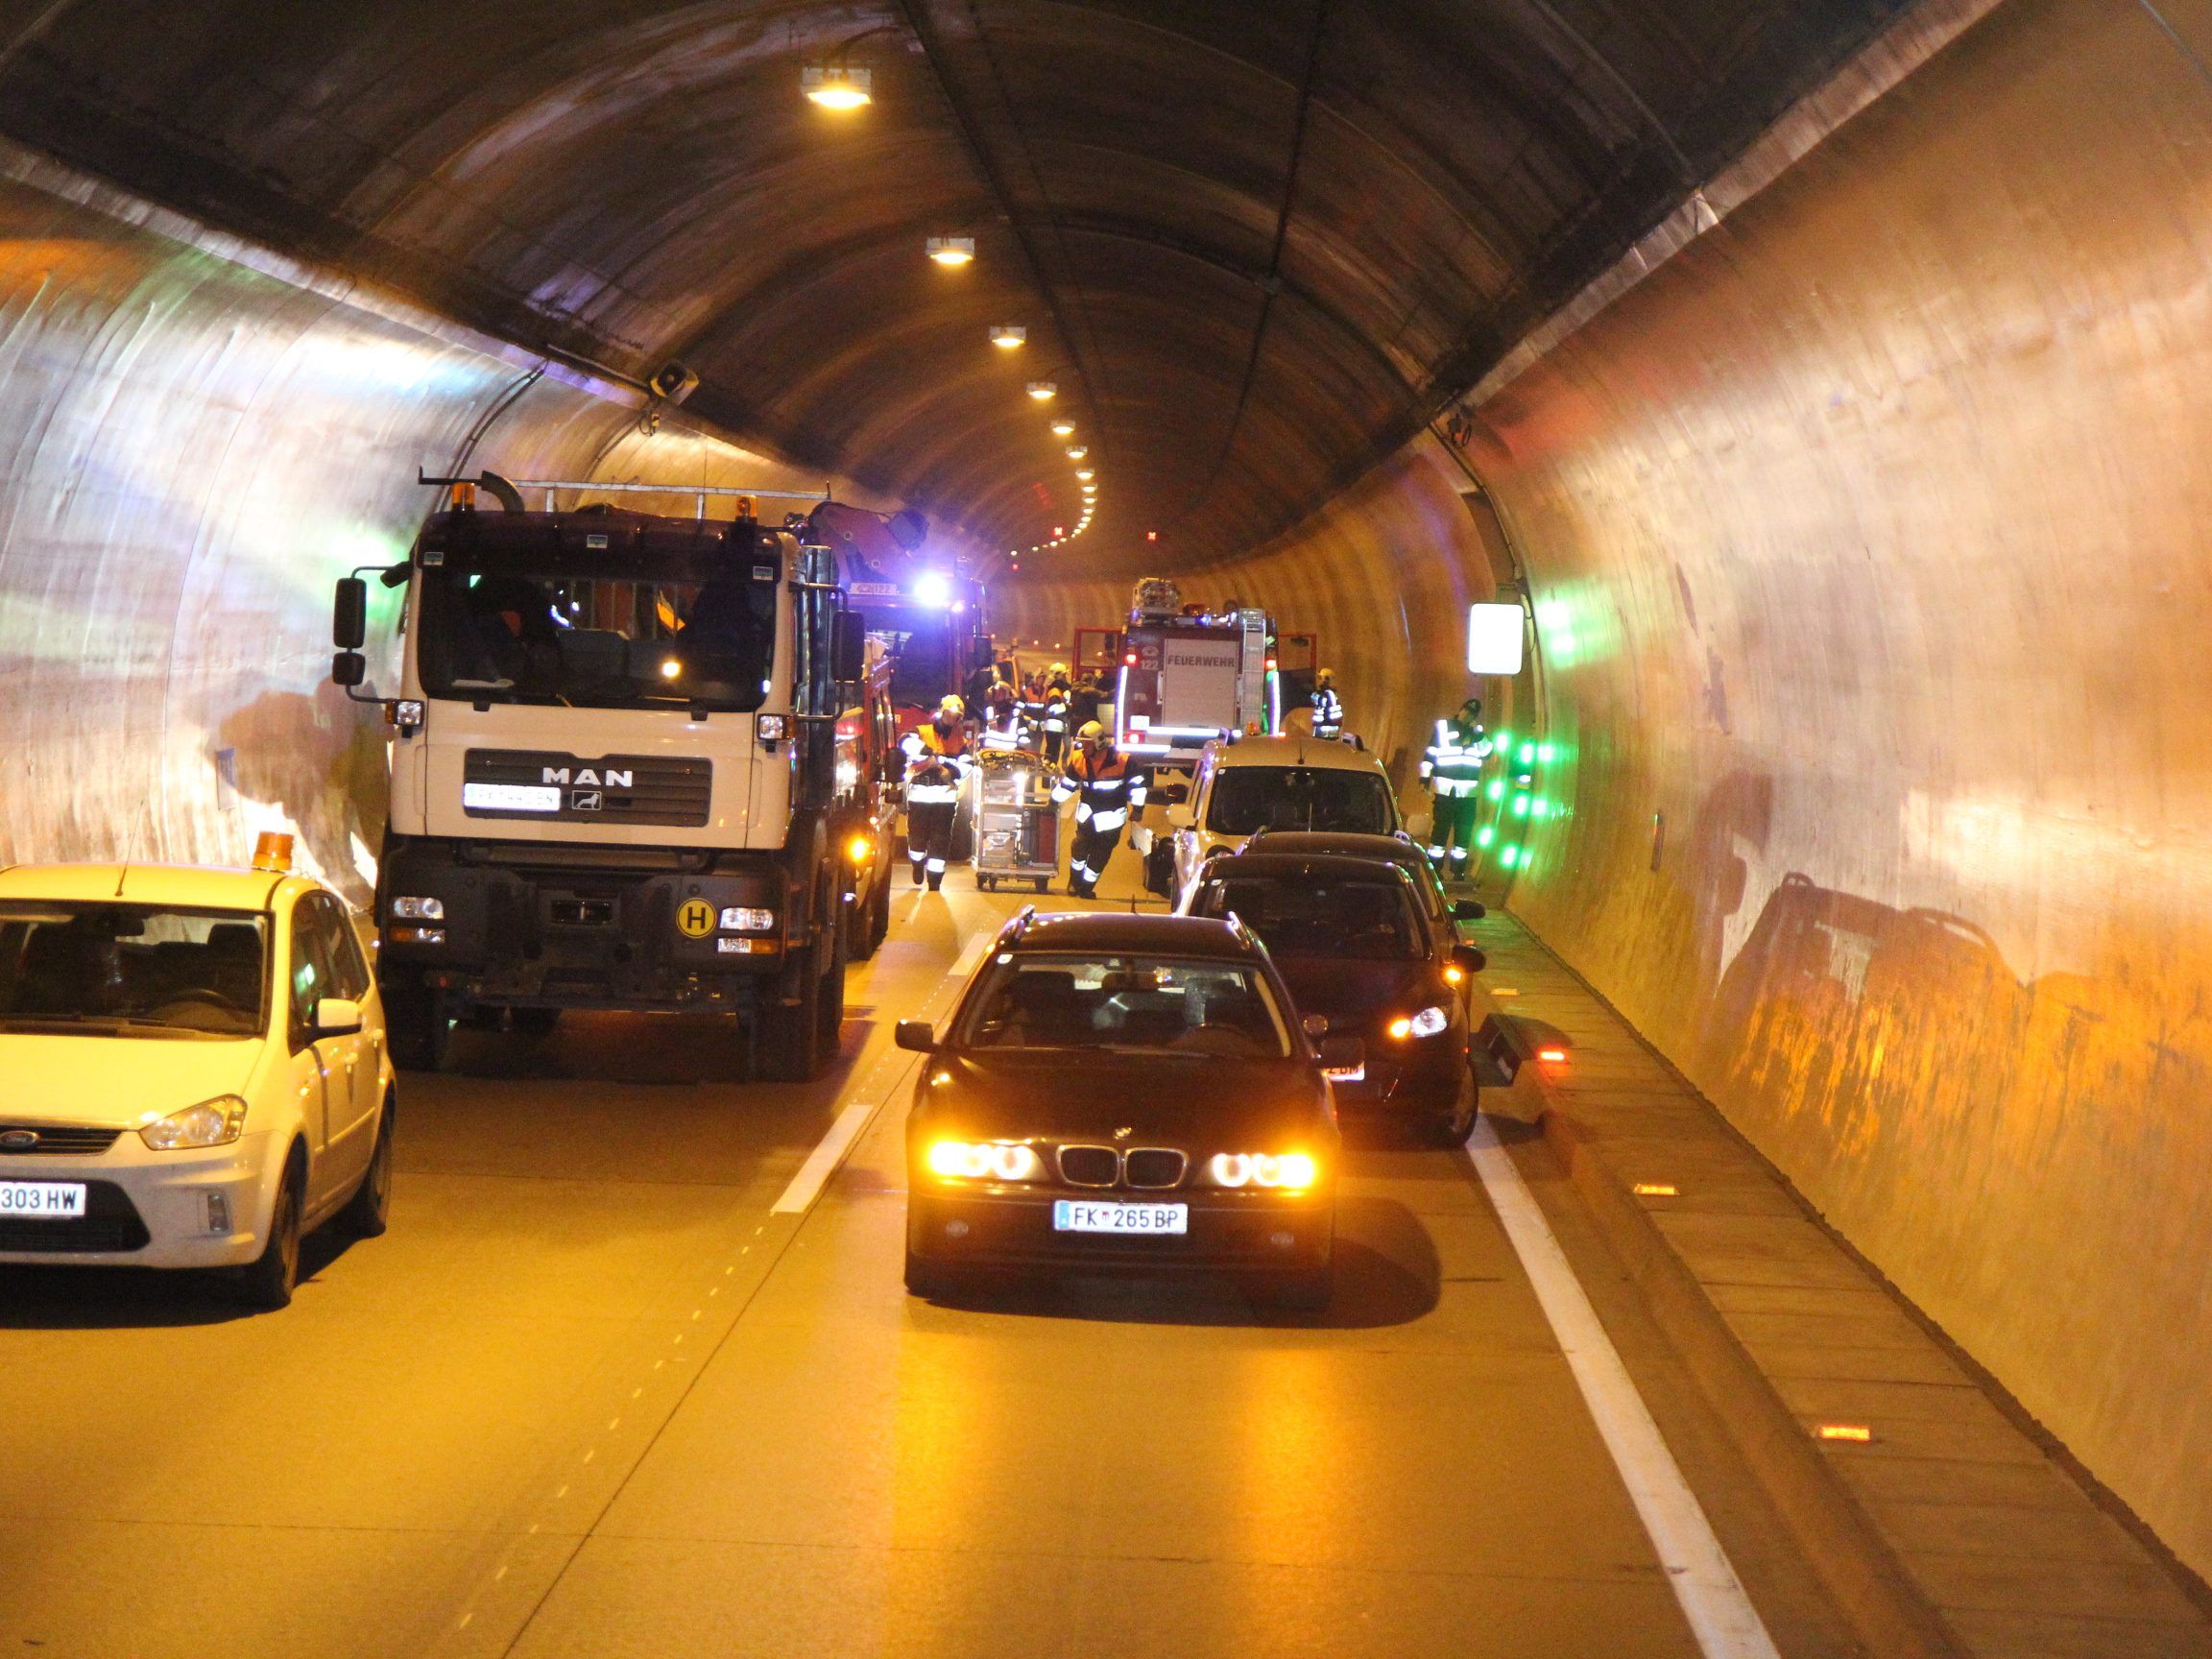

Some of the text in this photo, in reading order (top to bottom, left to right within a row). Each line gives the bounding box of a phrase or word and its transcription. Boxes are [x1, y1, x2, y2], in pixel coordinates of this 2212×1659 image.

[1142, 659, 1159, 670] 122
[1167, 655, 1235, 667] FEUERWEHR
[542, 767, 633, 787] MAN
[686, 906, 707, 929] H
[1, 1188, 77, 1210] 303 HW
[1074, 1207, 1178, 1228] FK 265 BP
